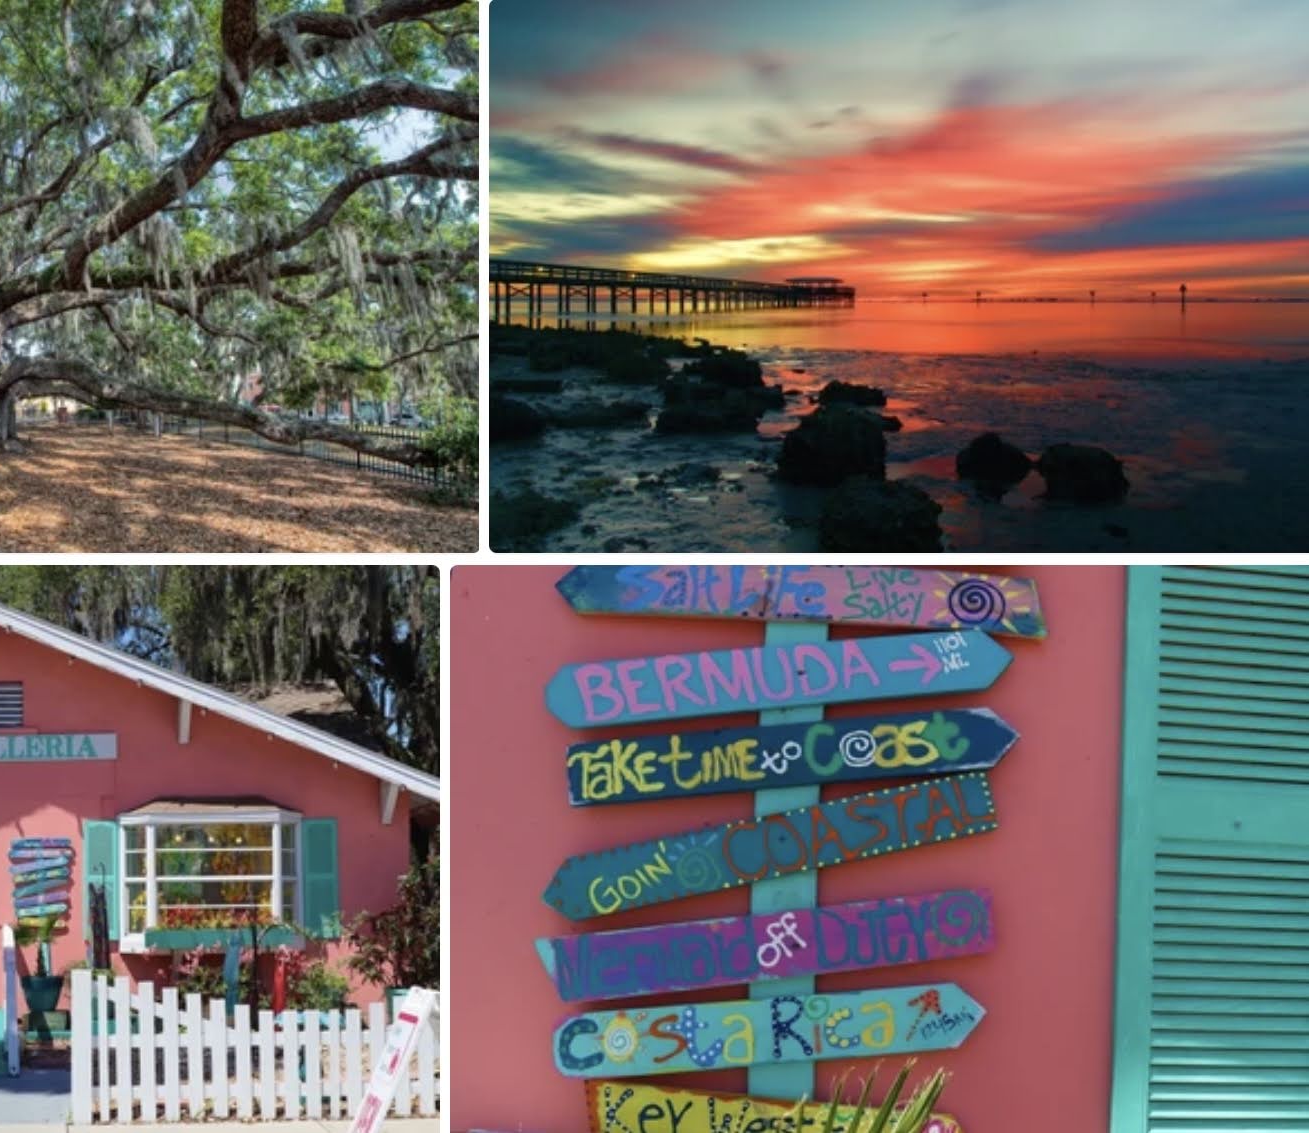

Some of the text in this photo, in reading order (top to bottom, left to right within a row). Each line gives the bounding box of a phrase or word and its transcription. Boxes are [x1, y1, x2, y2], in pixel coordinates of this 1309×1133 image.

[842, 591, 925, 625] Salty
[574, 640, 880, 721] BERMUDA
[761, 741, 803, 775] to
[722, 777, 995, 881] COASTAL
[756, 912, 807, 967] off
